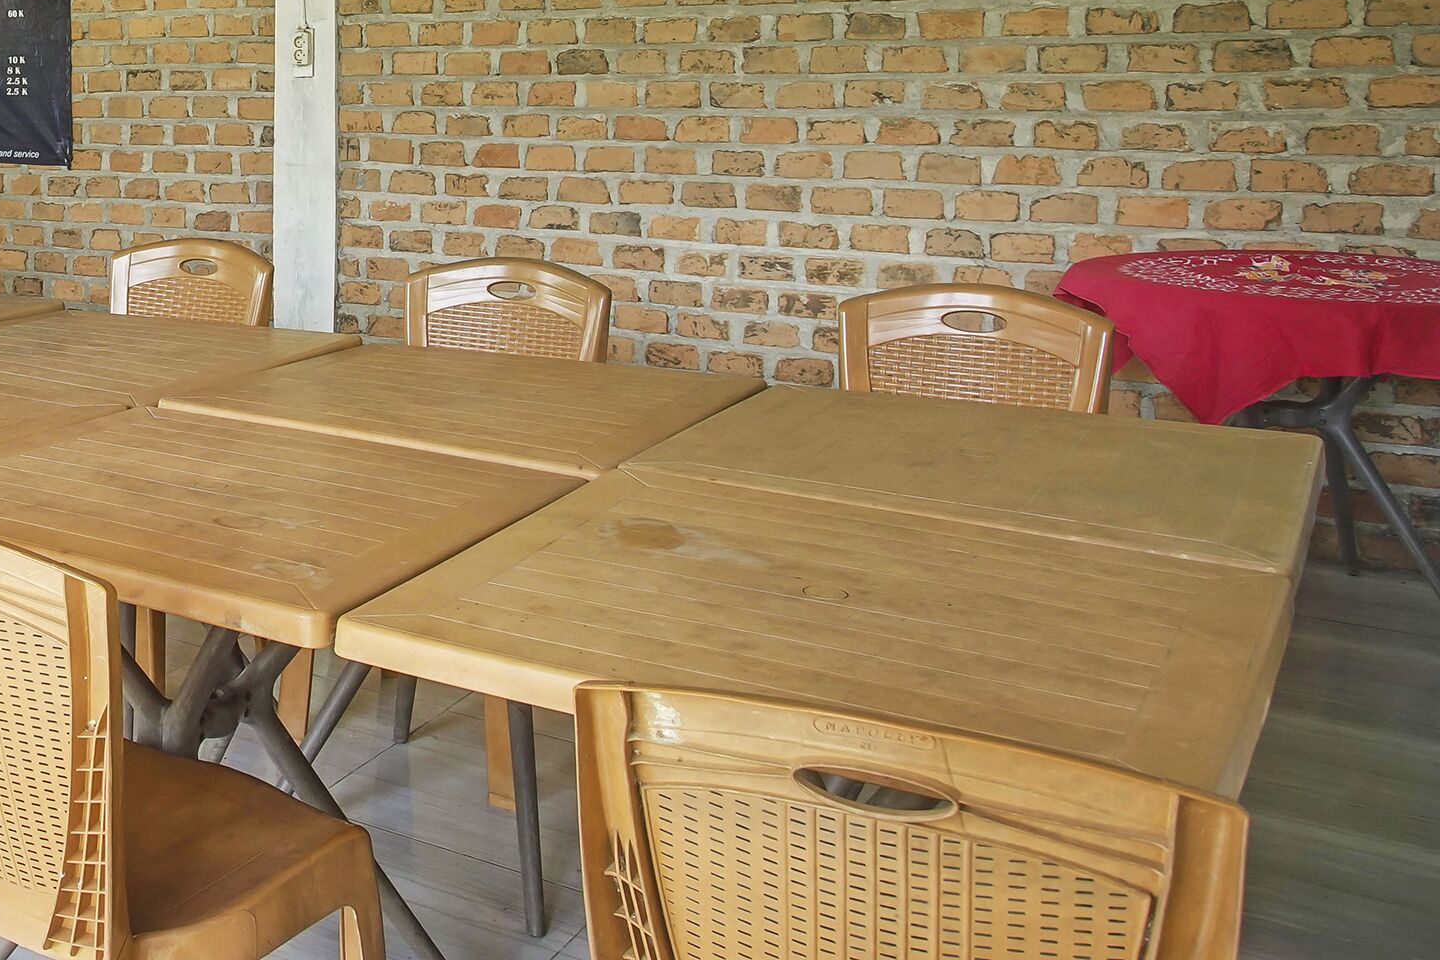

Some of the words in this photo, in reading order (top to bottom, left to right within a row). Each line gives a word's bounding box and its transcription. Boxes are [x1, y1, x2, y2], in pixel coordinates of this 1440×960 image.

[8, 56, 18, 64] 10
[19, 56, 25, 64] K
[15, 67, 21, 75] K
[22, 77, 28, 85] K
[13, 150, 39, 159] service
